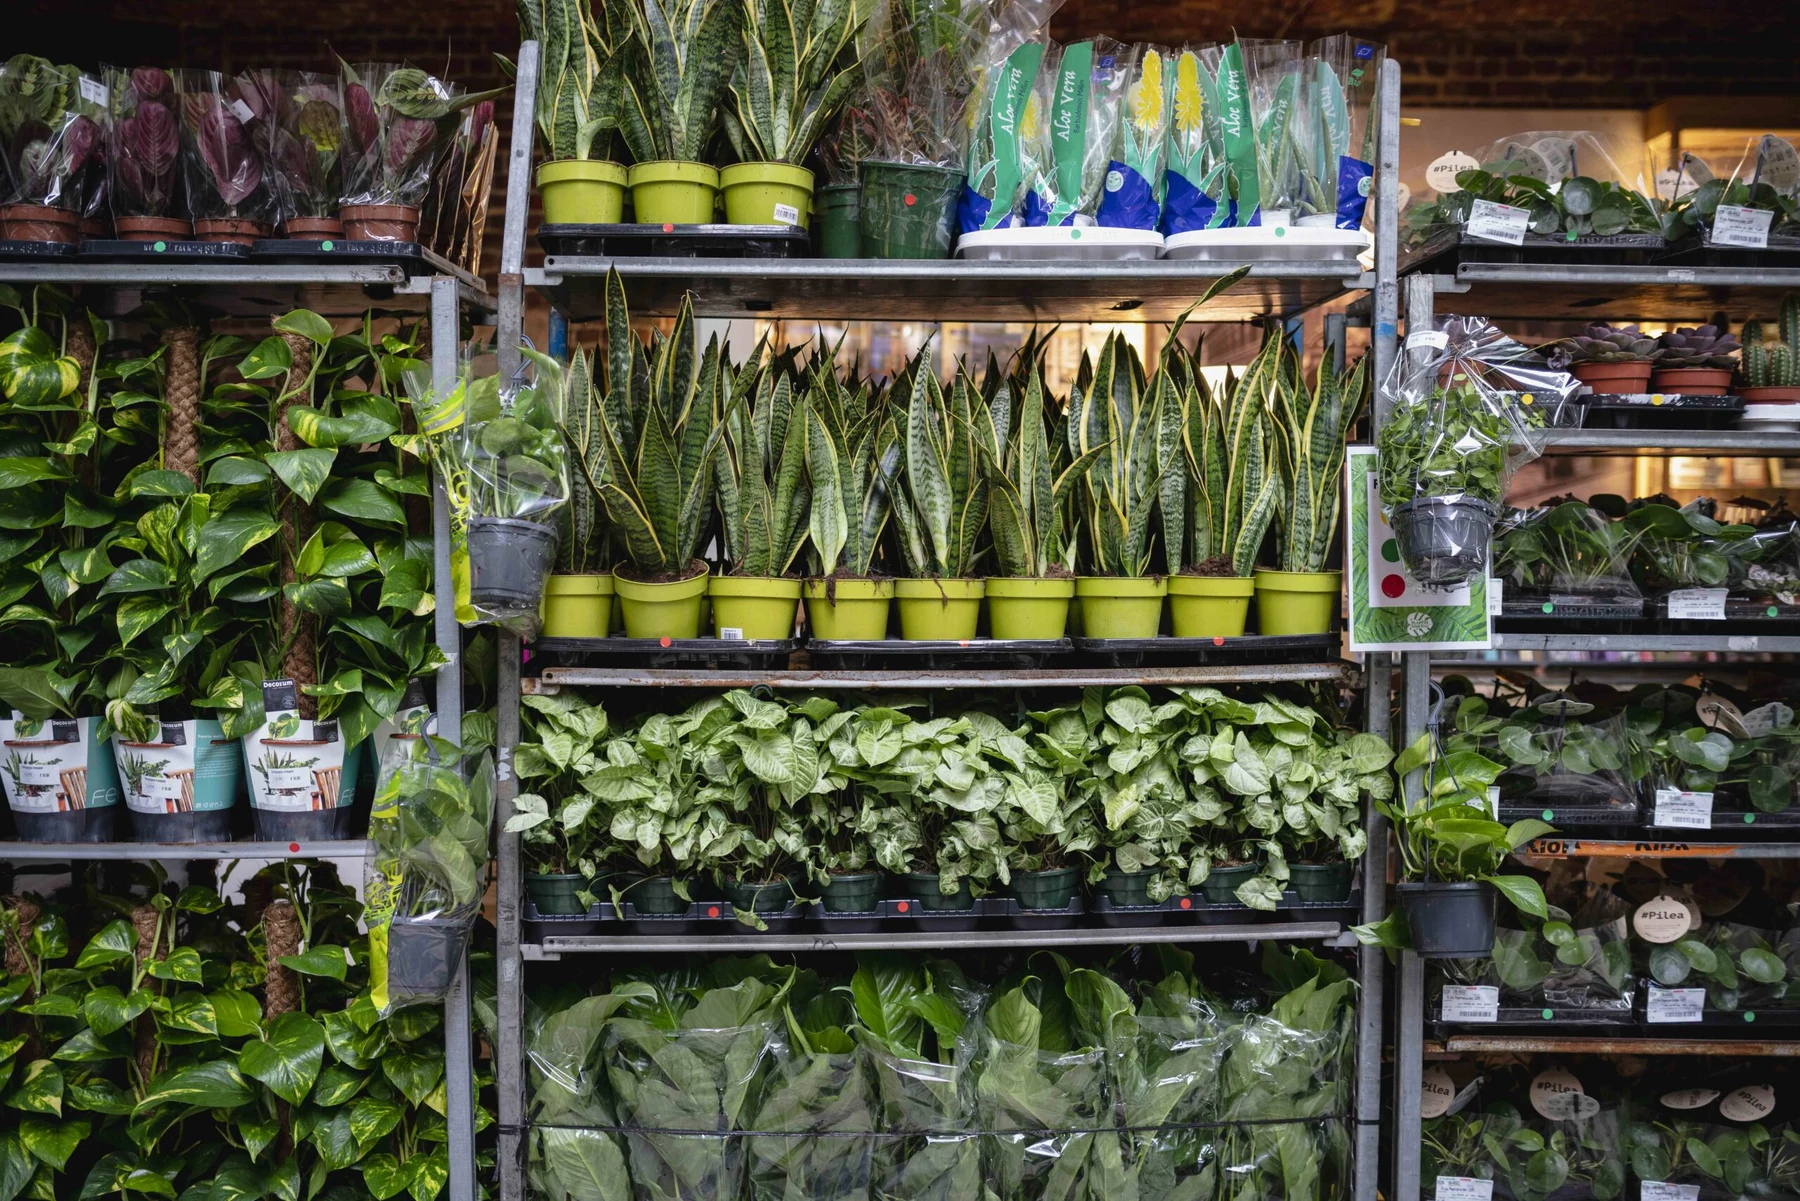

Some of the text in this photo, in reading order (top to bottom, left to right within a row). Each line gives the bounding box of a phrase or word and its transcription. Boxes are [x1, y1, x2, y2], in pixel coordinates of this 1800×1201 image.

[1053, 70, 1076, 142] Aloe Vera
[1220, 69, 1241, 138] Aloe Vera
[997, 103, 1014, 136] Aloe
[1433, 164, 1474, 172] #Pilea
[263, 680, 293, 688] Decorum
[1641, 910, 1685, 920] #Pilea
[1737, 1090, 1767, 1112] #Pilea
